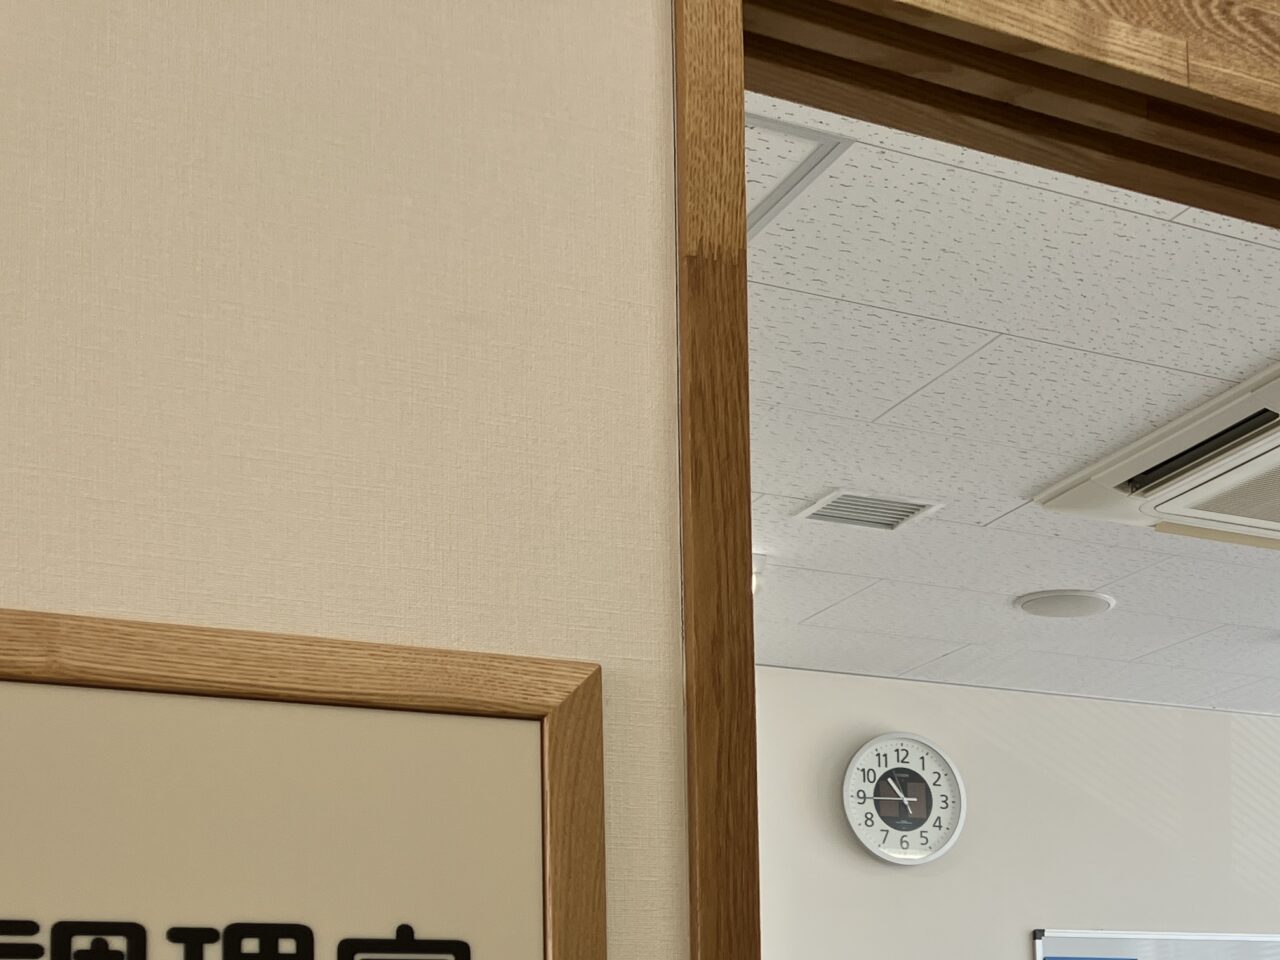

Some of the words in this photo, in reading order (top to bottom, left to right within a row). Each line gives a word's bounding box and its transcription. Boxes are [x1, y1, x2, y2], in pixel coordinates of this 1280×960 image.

[875, 752, 889, 768] 11
[894, 748, 909, 764] 12
[919, 755, 926, 771] 1
[861, 768, 877, 784] 10
[932, 771, 942, 787] 2
[856, 789, 867, 805] 9
[939, 794, 949, 810] 3
[864, 811, 875, 828] 8
[932, 815, 943, 831] 4
[880, 829, 890, 845] 7
[900, 834, 910, 850] 6
[920, 830, 929, 846] 5
